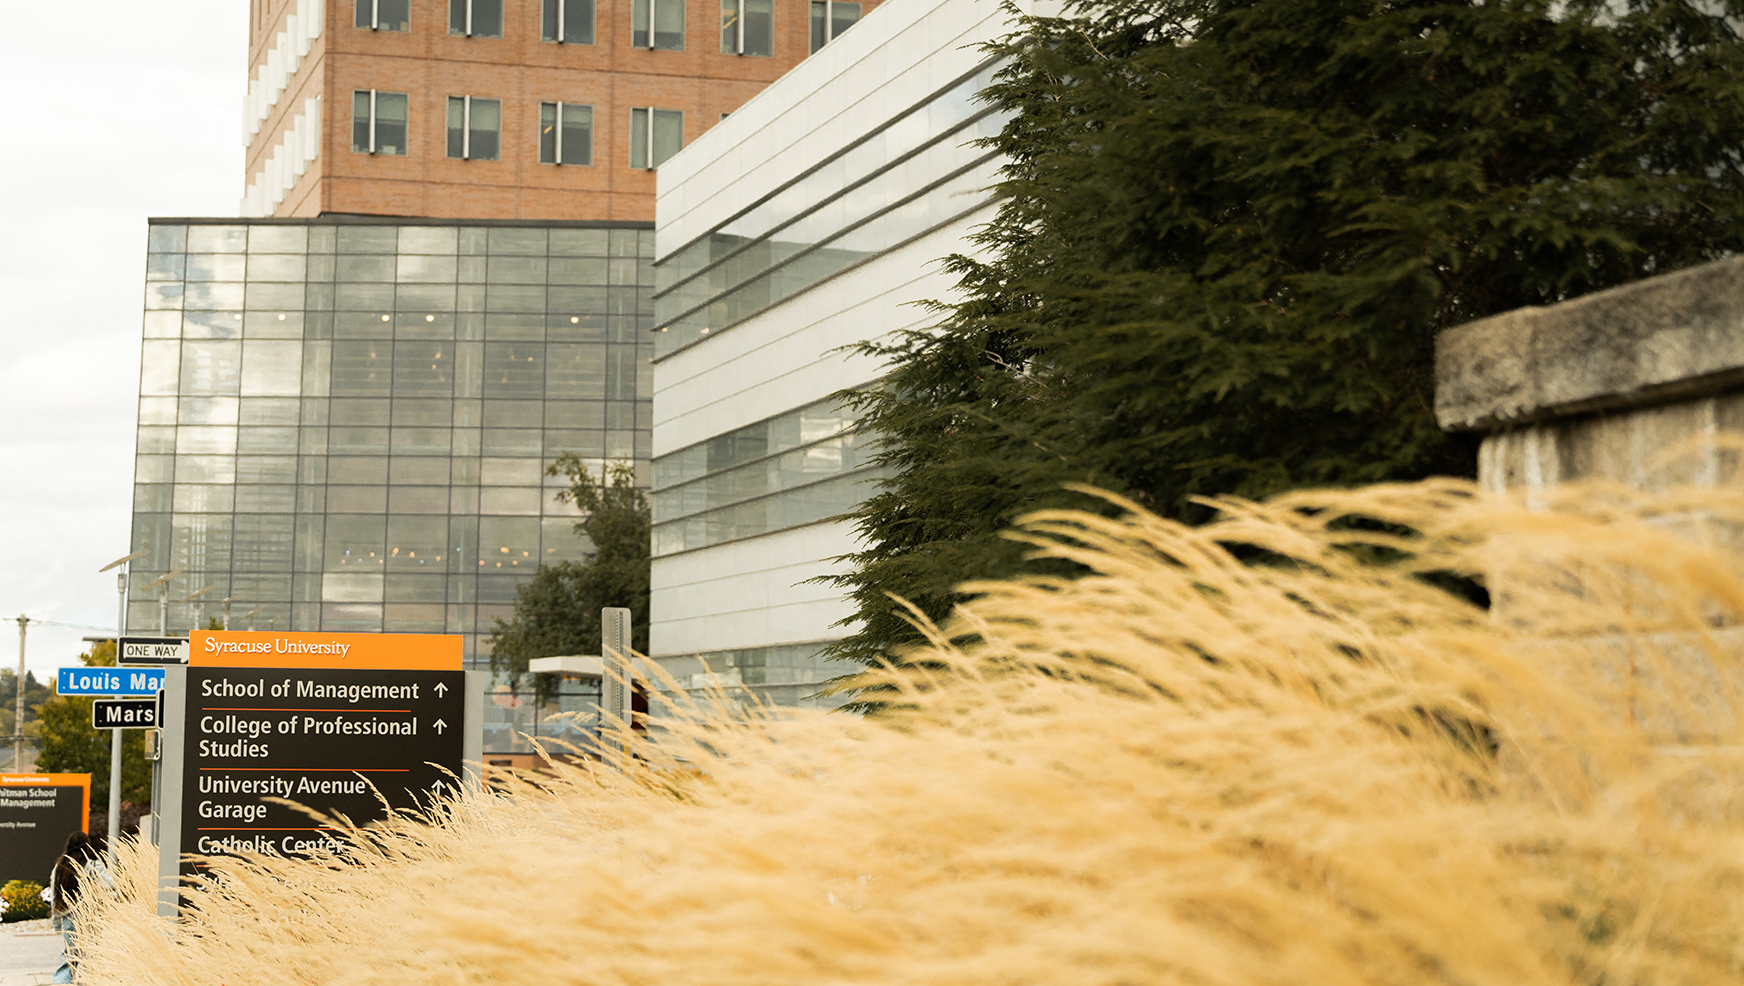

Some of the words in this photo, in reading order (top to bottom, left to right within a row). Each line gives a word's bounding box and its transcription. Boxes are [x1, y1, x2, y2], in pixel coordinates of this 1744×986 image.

[126, 645, 150, 656] ONE
[154, 646, 178, 656] WAY
[204, 637, 272, 656] Syracuse
[275, 638, 350, 658] University
[69, 672, 120, 690] Louis
[201, 678, 264, 698] School
[270, 679, 291, 698] of
[296, 680, 419, 703] Management
[106, 706, 154, 722] Mars
[200, 715, 272, 738] College
[278, 716, 298, 735] of
[303, 717, 418, 736] Professional
[199, 739, 269, 758] Studies
[28, 788, 57, 797] School
[199, 776, 294, 798] University
[296, 777, 366, 795] Avenue
[0, 798, 56, 809] Management
[198, 801, 267, 822] Garage
[197, 835, 275, 854] Catholic
